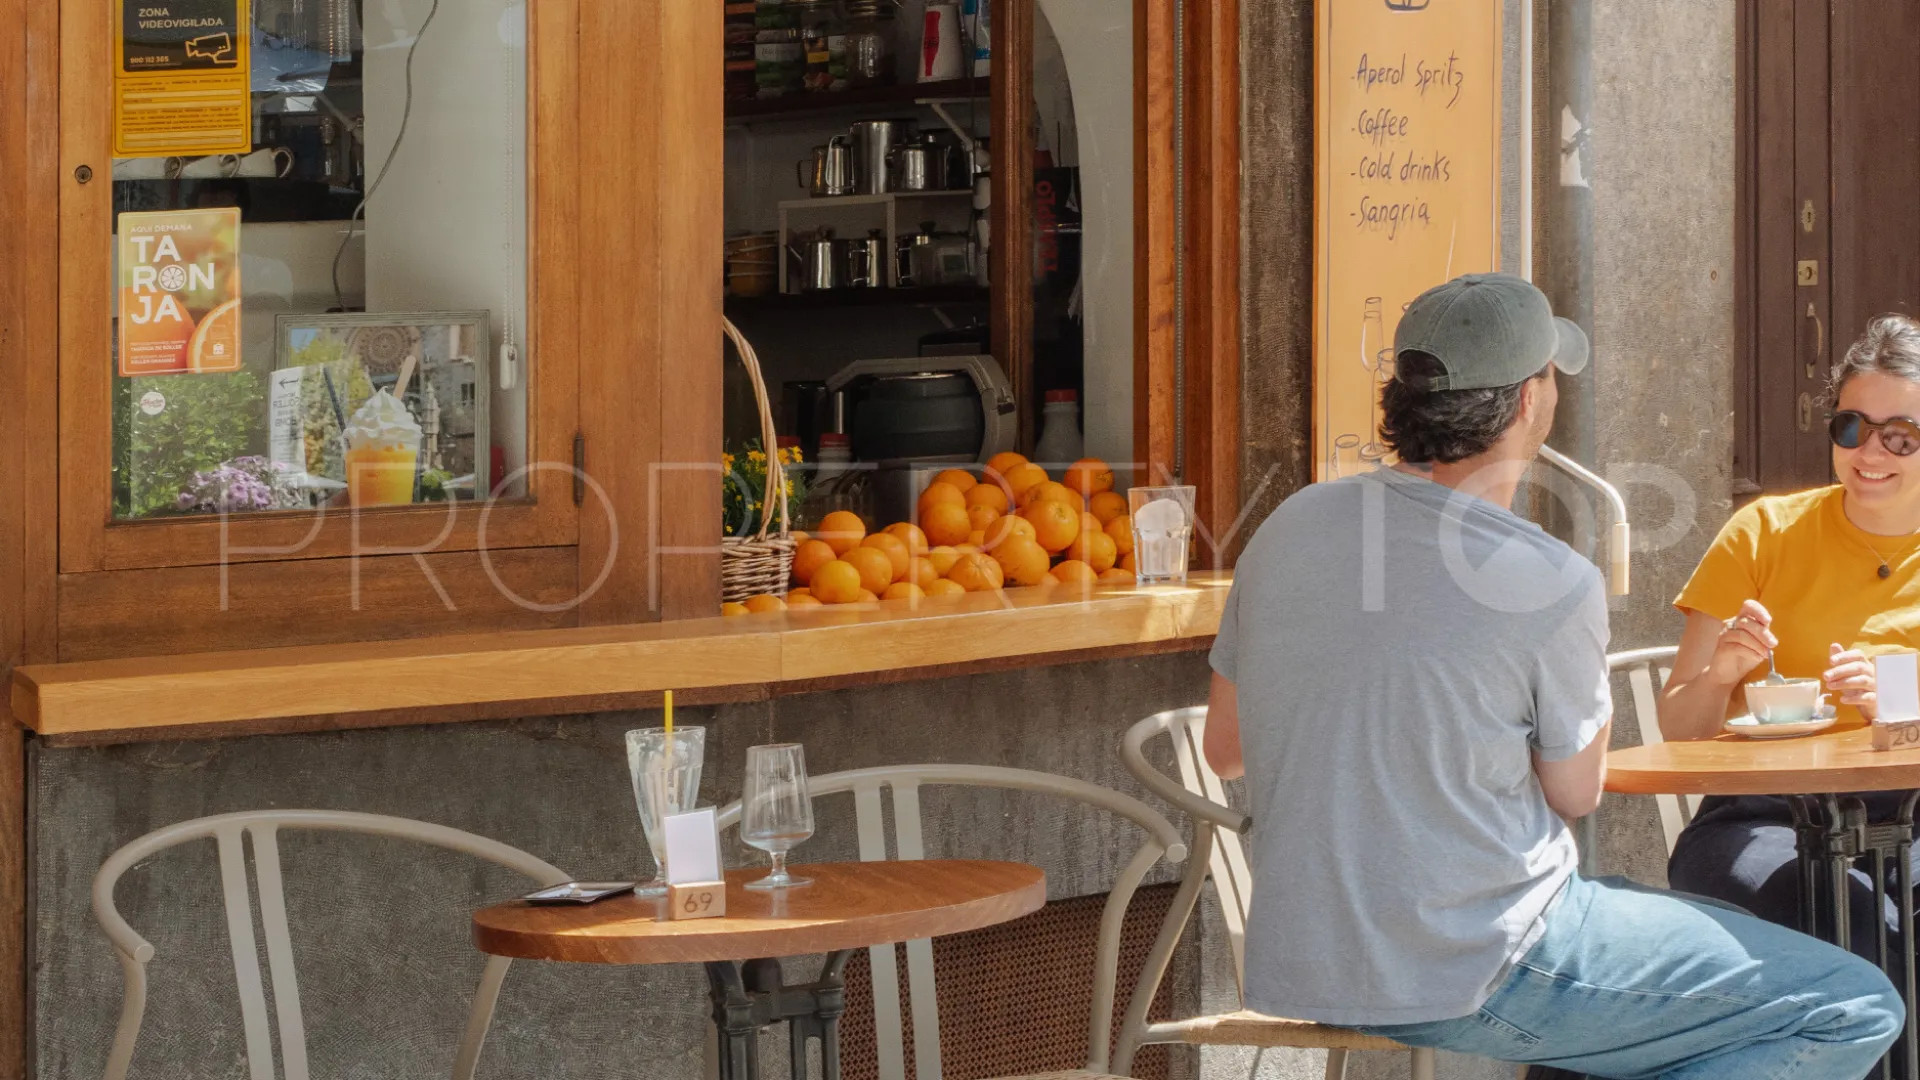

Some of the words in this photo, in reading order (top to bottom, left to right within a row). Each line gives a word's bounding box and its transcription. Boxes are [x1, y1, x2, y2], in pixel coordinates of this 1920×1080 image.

[138, 7, 170, 18] ZONA
[138, 17, 224, 30] VIDEOVIGILADA
[1415, 50, 1463, 109] Spritz
[130, 235, 182, 263] TA
[130, 294, 182, 325] JA
[684, 892, 713, 913] 69
